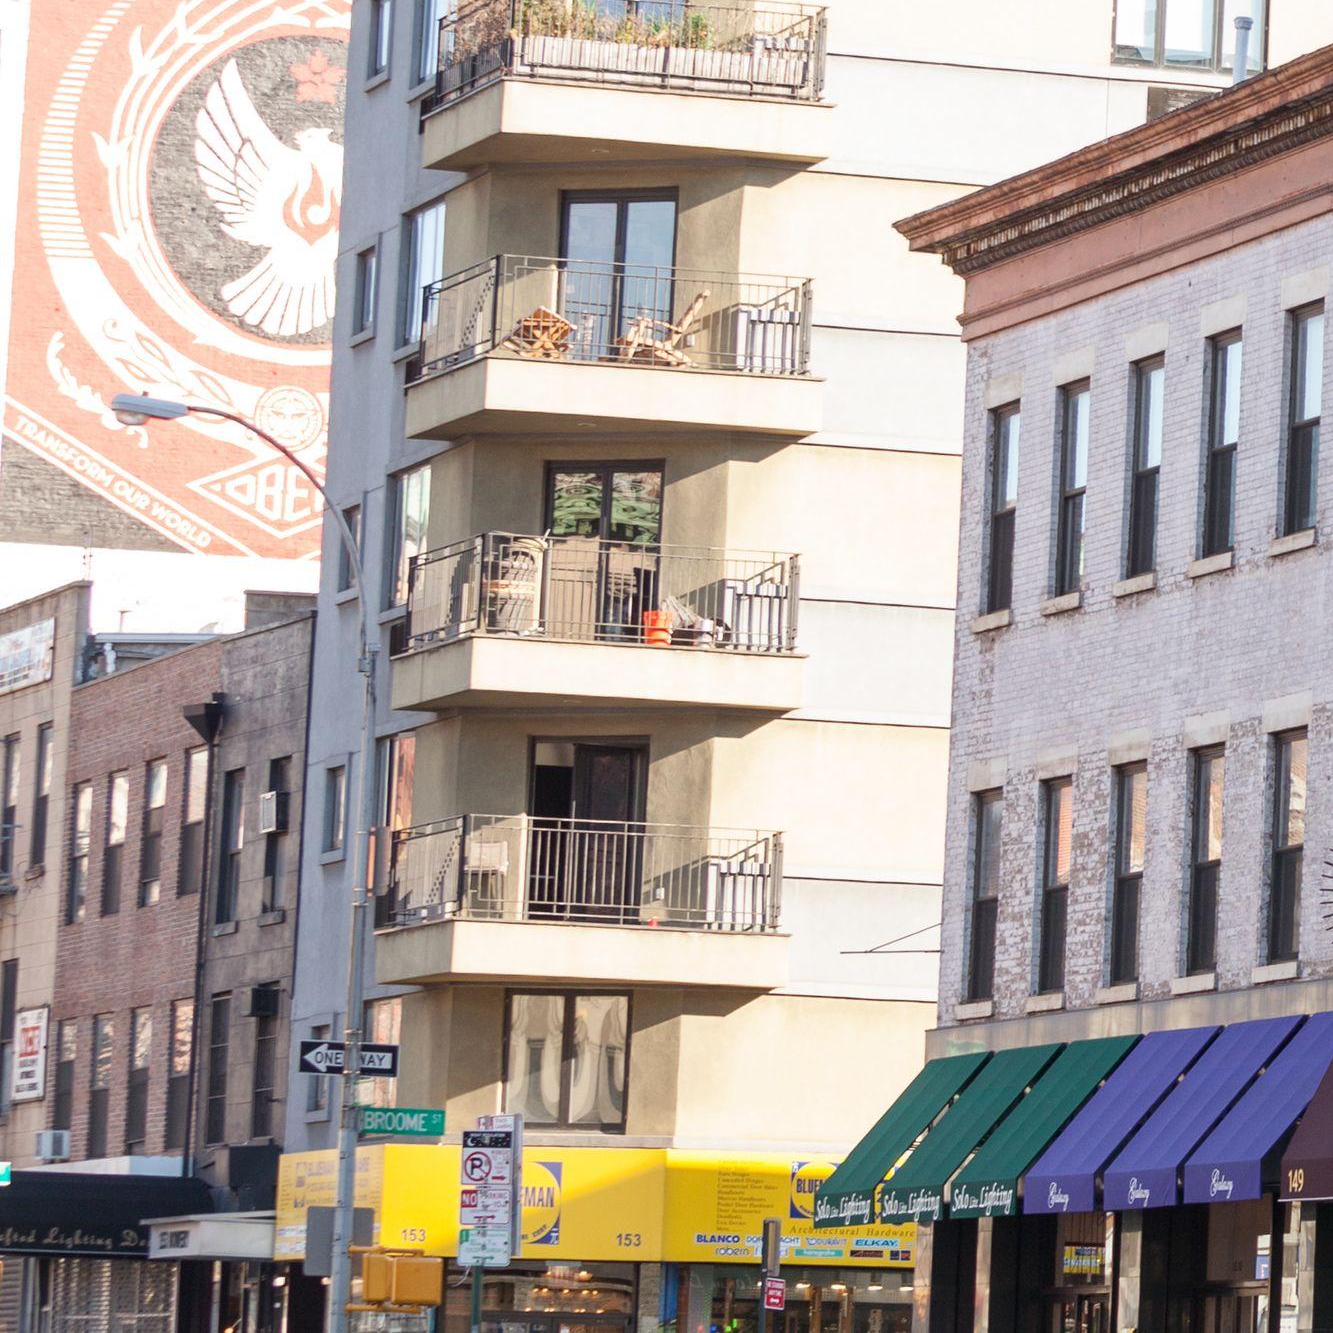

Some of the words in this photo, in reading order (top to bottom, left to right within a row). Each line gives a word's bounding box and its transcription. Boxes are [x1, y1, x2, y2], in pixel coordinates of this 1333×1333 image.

[14, 414, 116, 488] TRANSFORM
[112, 479, 152, 511] OUR
[149, 501, 212, 548] WORLD
[314, 1051, 343, 1065] ONE
[364, 1110, 428, 1132] BROOME
[432, 1113, 442, 1124] ST
[1288, 1169, 1304, 1193] 149
[521, 1186, 555, 1208] MAN
[883, 1190, 899, 1217] Solo
[908, 1188, 941, 1222] Lighting
[952, 1184, 969, 1212] Solo
[979, 1181, 1014, 1216] Lighting
[815, 1196, 831, 1222] Solo
[839, 1192, 871, 1225] Lighting
[42, 1226, 113, 1250] Lighting
[402, 1228, 426, 1243] 153
[616, 1233, 642, 1247] 153
[696, 1234, 741, 1244] BLANCO
[855, 1238, 898, 1247] ELKAY
[866, 1224, 916, 1238] Hardware
